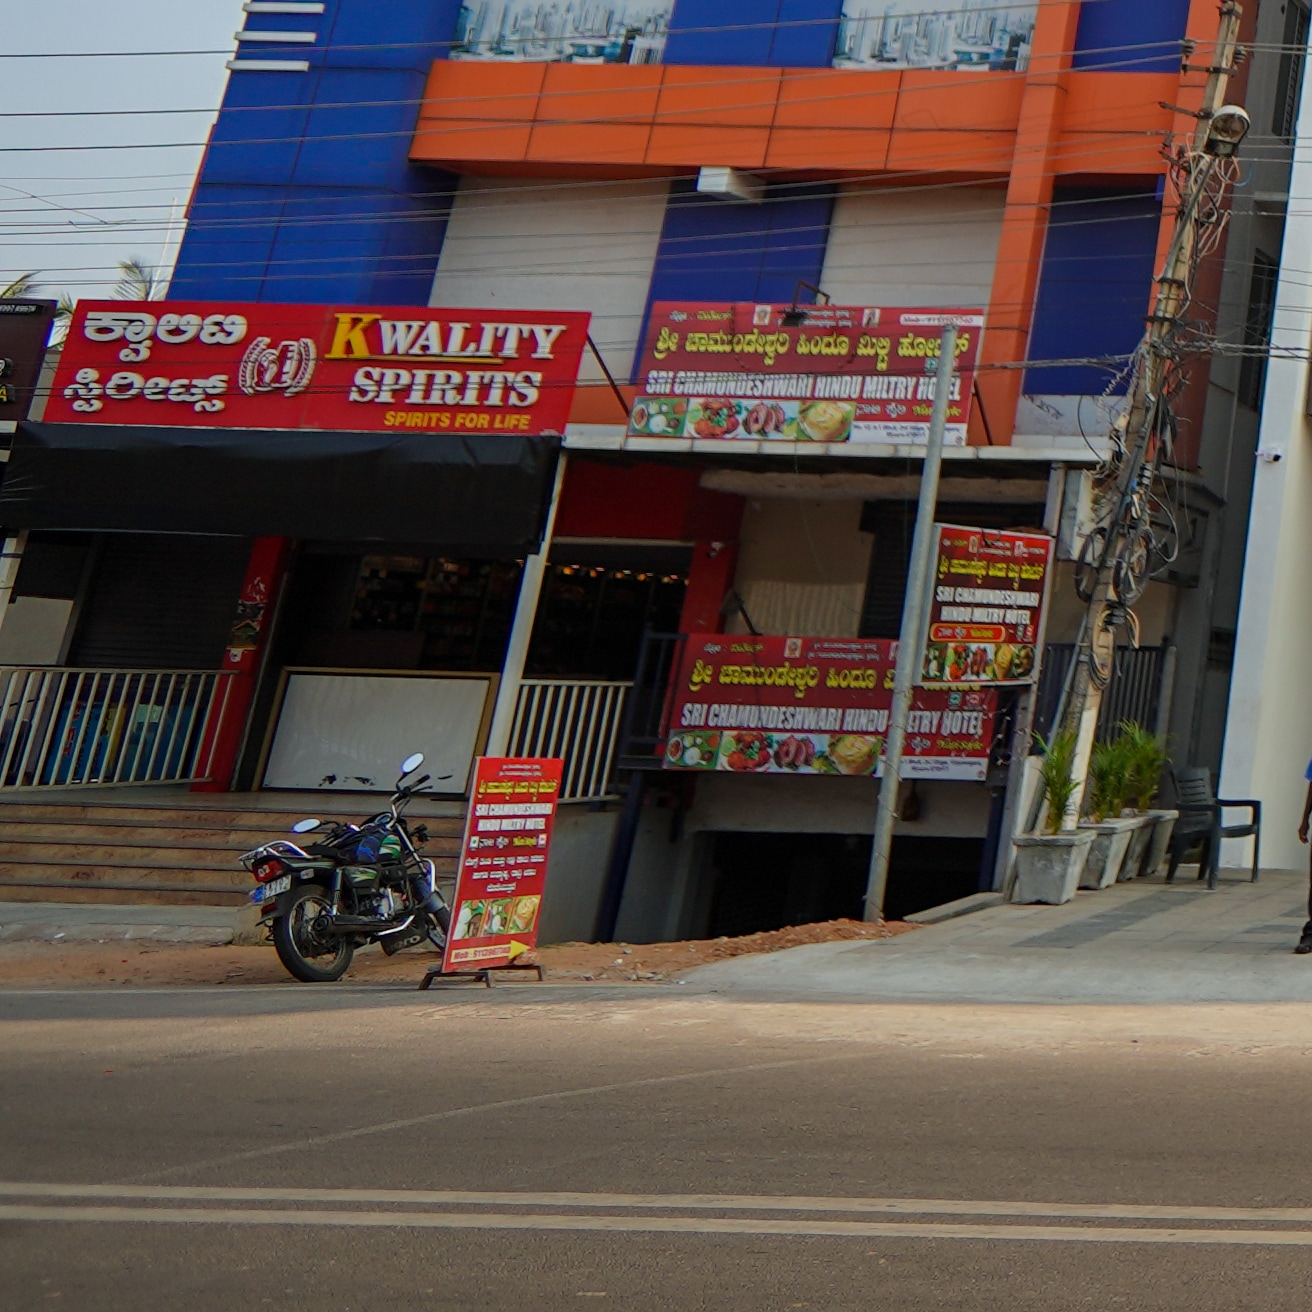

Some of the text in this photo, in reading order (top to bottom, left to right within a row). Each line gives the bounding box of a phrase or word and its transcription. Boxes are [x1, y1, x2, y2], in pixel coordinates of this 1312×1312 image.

[84, 311, 249, 363] ಕ್ವಾಲಿಟಿ
[325, 313, 567, 360] KWALITY
[350, 366, 543, 407] SPIRITS
[646, 369, 675, 395] SRI
[814, 374, 863, 399] HINDU
[862, 374, 917, 400] MILTRY
[916, 377, 961, 401] HOEL
[384, 410, 531, 430] SPIRITS FOR LIFE
[682, 703, 708, 727] SRI
[708, 704, 843, 730] CHAMUNDESHWARI
[842, 709, 889, 733] HINDU
[940, 710, 984, 736] HOTEL
